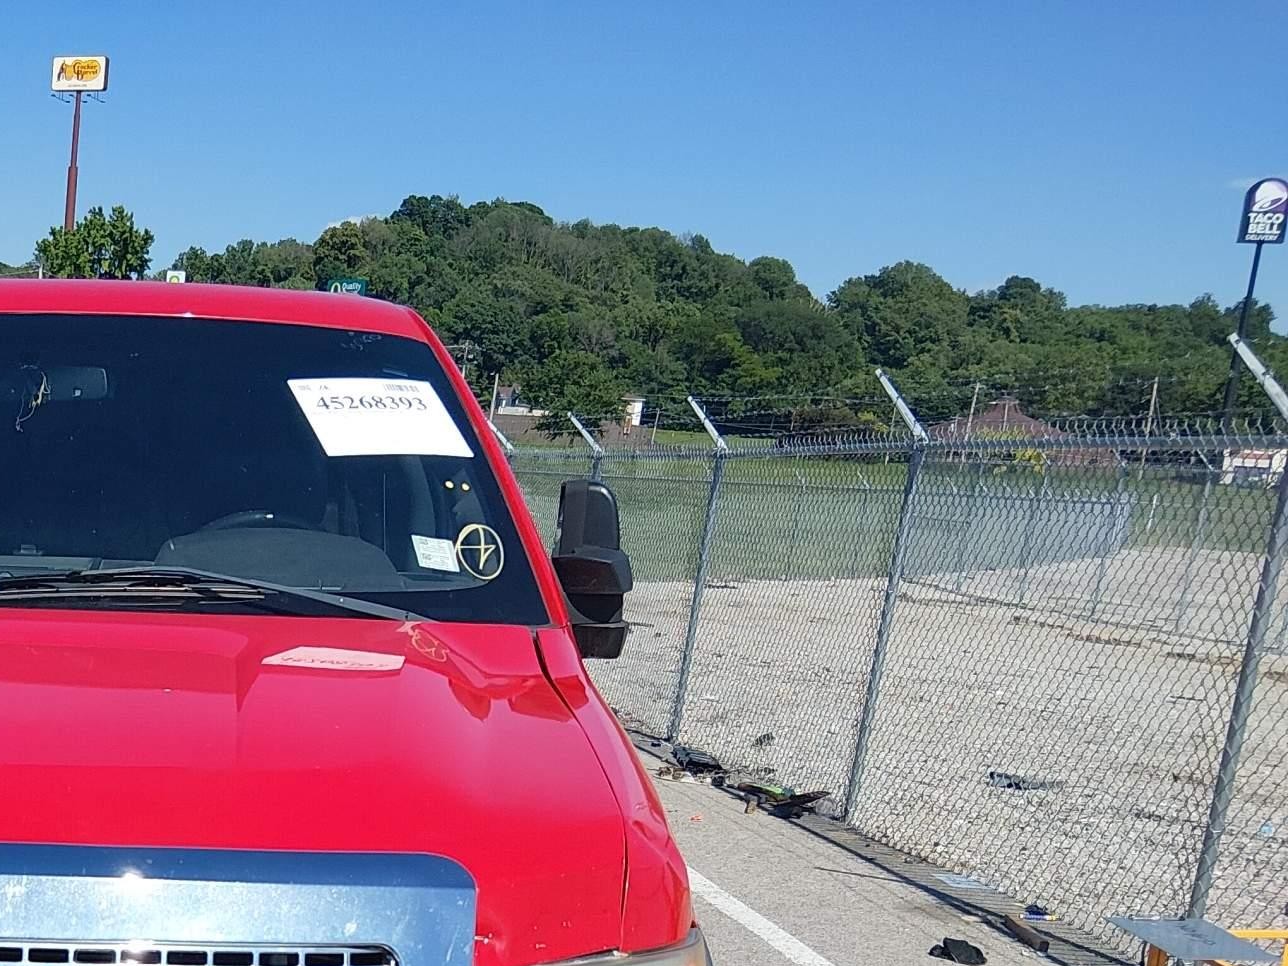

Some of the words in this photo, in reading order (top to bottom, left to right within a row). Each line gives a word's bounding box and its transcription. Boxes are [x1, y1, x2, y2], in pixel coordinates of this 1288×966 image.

[1247, 212, 1285, 224] TACO
[1247, 223, 1281, 234] BELL
[342, 282, 362, 290] Quality
[317, 395, 428, 411] 45268393
